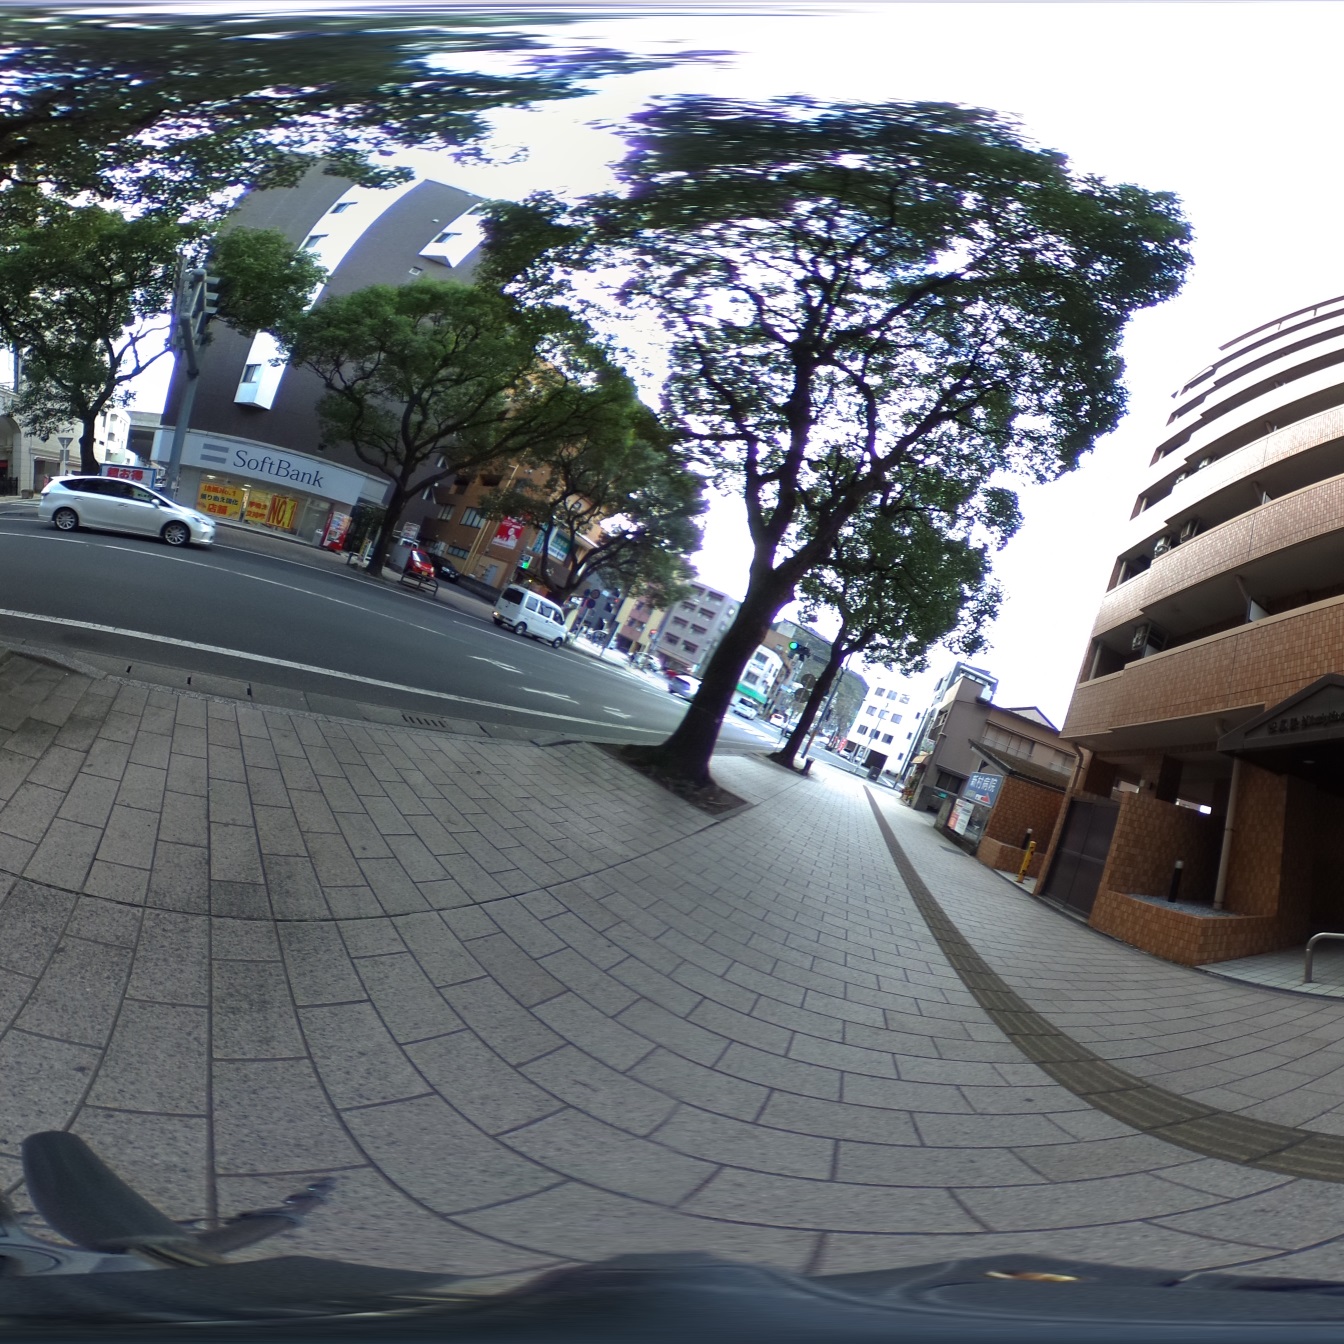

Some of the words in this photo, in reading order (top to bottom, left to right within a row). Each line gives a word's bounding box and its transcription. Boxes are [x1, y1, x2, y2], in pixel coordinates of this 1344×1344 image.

[233, 449, 324, 488] SoftBank
[970, 775, 998, 793] 新村病院
